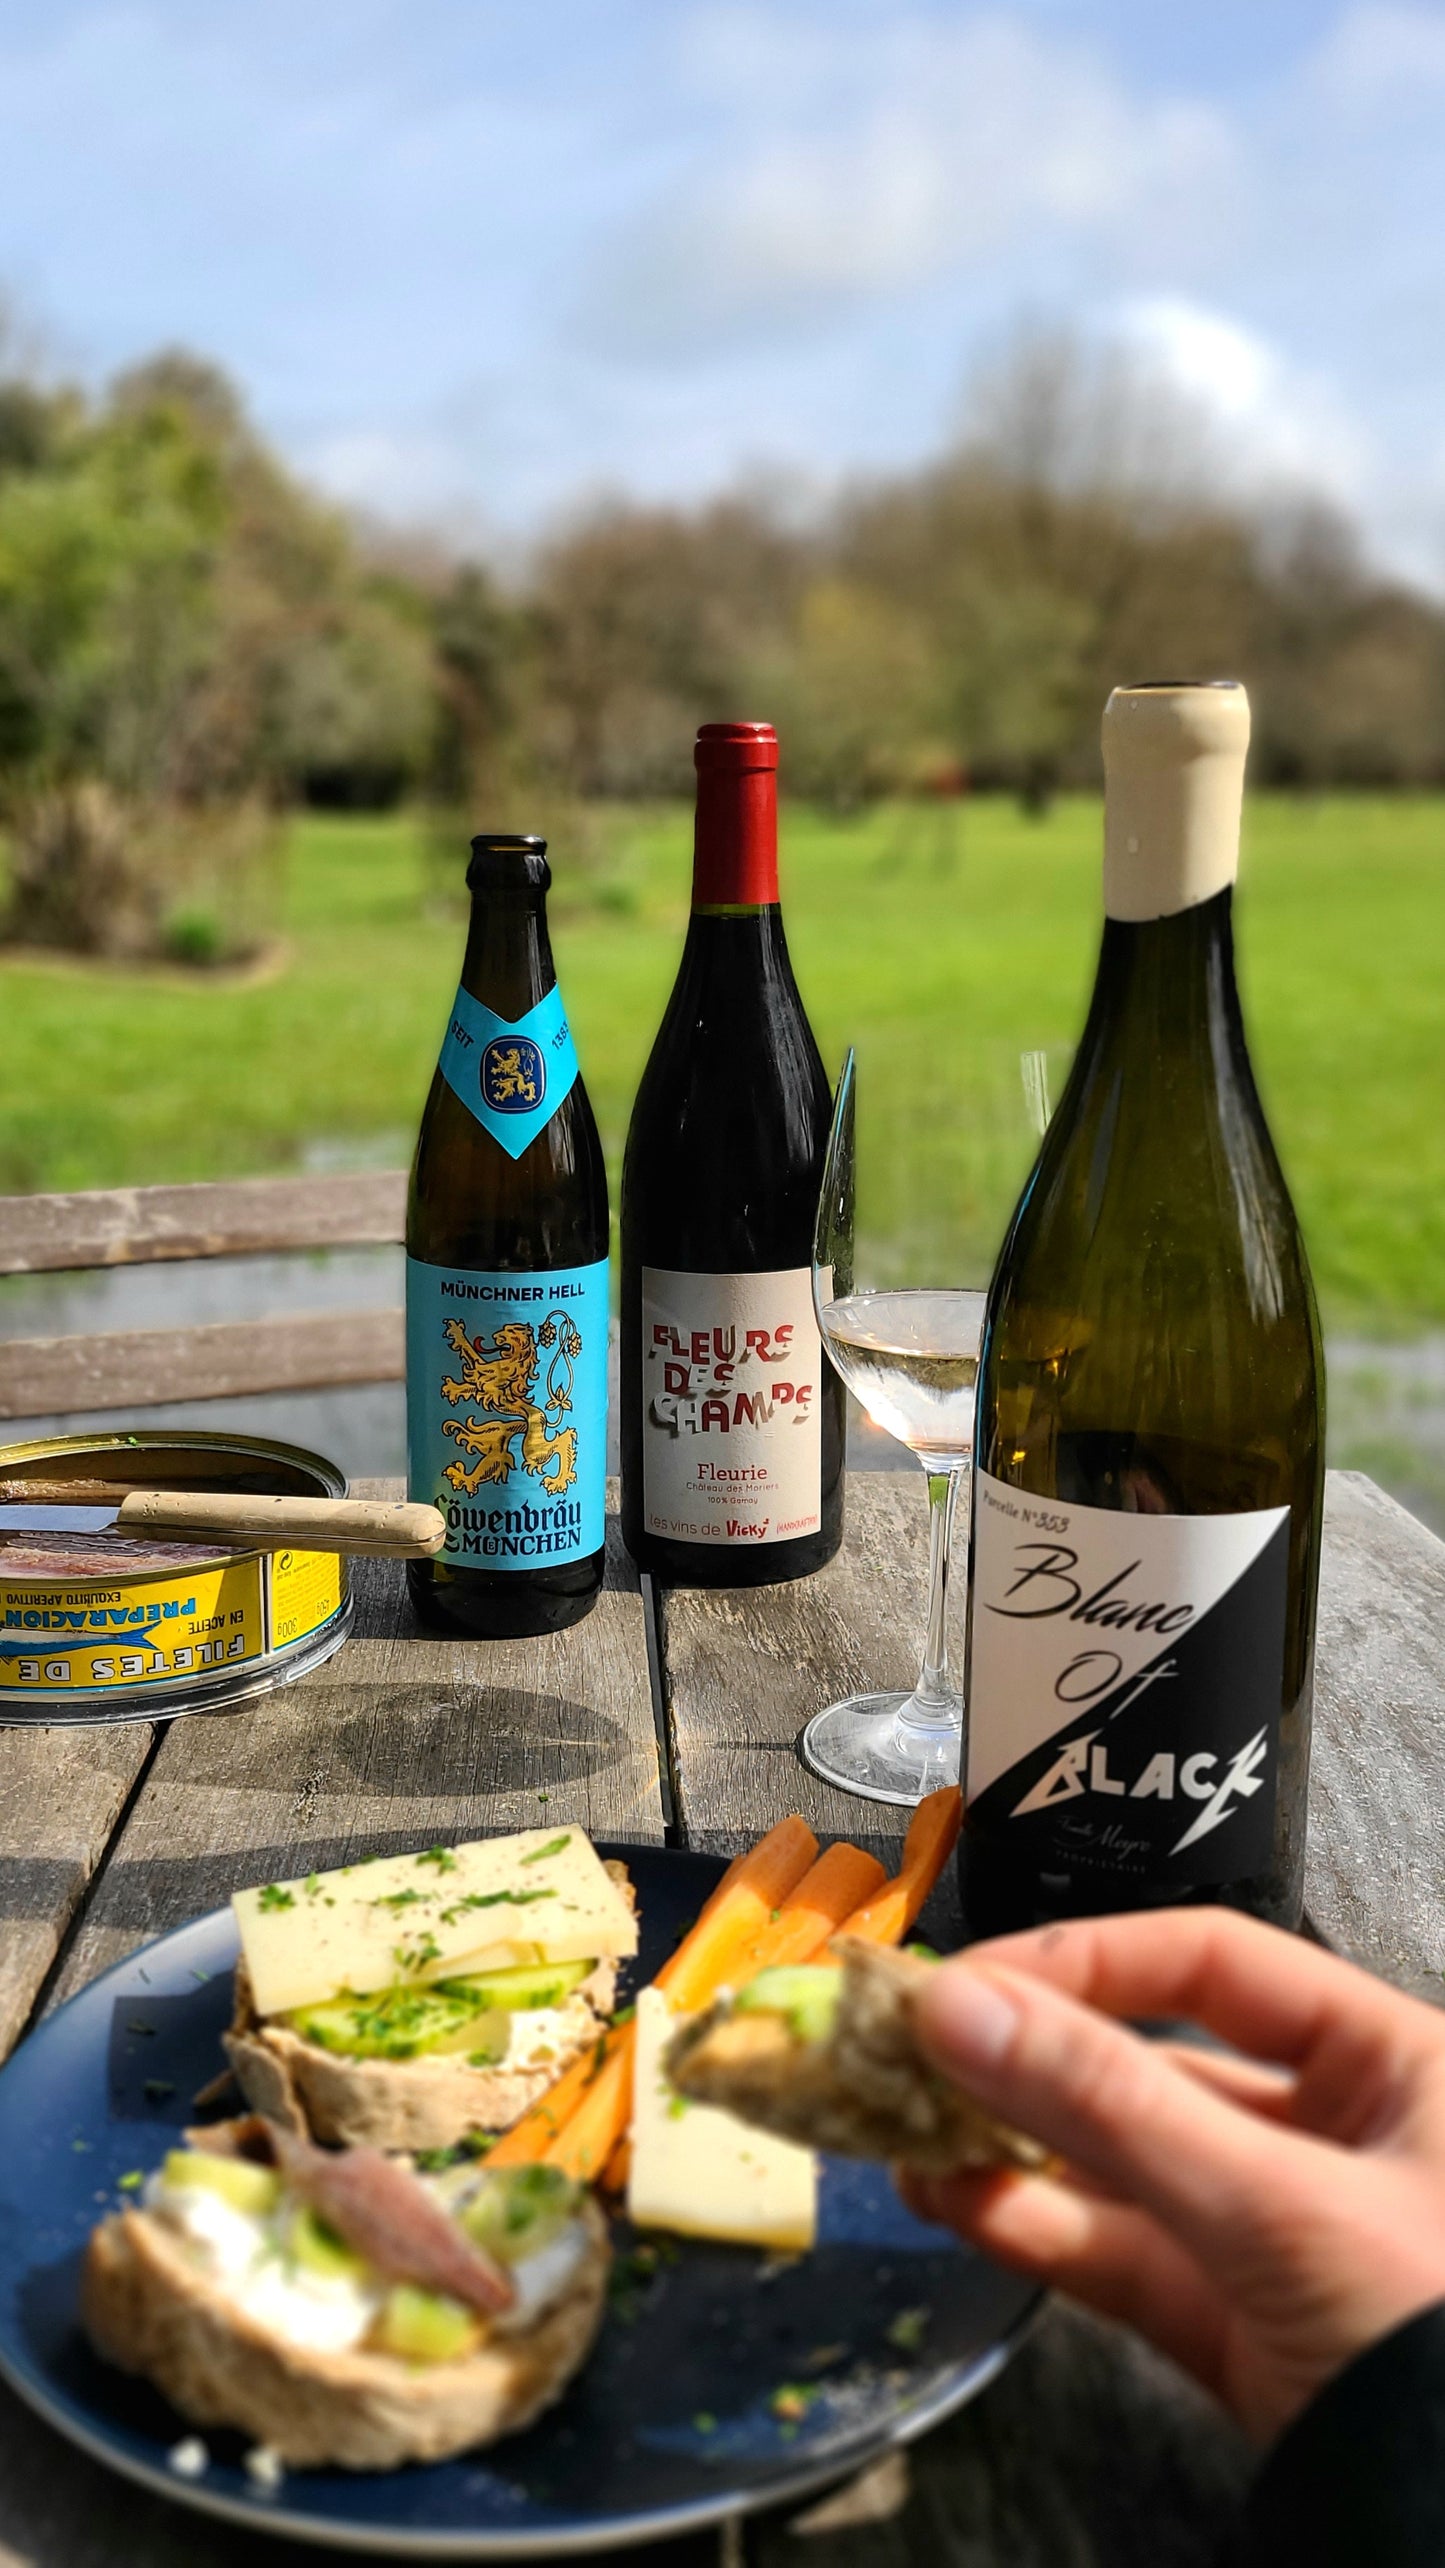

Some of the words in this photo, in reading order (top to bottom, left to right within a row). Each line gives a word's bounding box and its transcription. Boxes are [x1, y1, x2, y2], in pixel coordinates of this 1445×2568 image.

[451, 1020, 474, 1048] SEIT
[440, 1280, 544, 1301] MÜNCHNER
[549, 1283, 585, 1299] HELL
[653, 1324, 794, 1365] FLEURS
[664, 1362, 735, 1395] DES
[652, 1382, 813, 1434] CHAMPS
[697, 1463, 767, 1481] Fleurie
[686, 1481, 723, 1493] Château
[727, 1483, 743, 1493] des
[707, 1496, 728, 1504] 100%
[983, 1490, 1019, 1519] Parcelle
[670, 1519, 698, 1534] vins
[701, 1522, 721, 1536] de
[6, 1592, 63, 1605] APERITIVO
[984, 1543, 1194, 1634] Blanc
[5, 1597, 196, 1628] PREPARACION
[188, 1613, 226, 1635] ACEITE
[229, 1609, 244, 1625] EN
[18, 1659, 71, 1682] DE
[93, 1634, 245, 1680] FILETES
[1054, 1650, 1179, 1719] Of
[1009, 1722, 1269, 1857] BLACK
